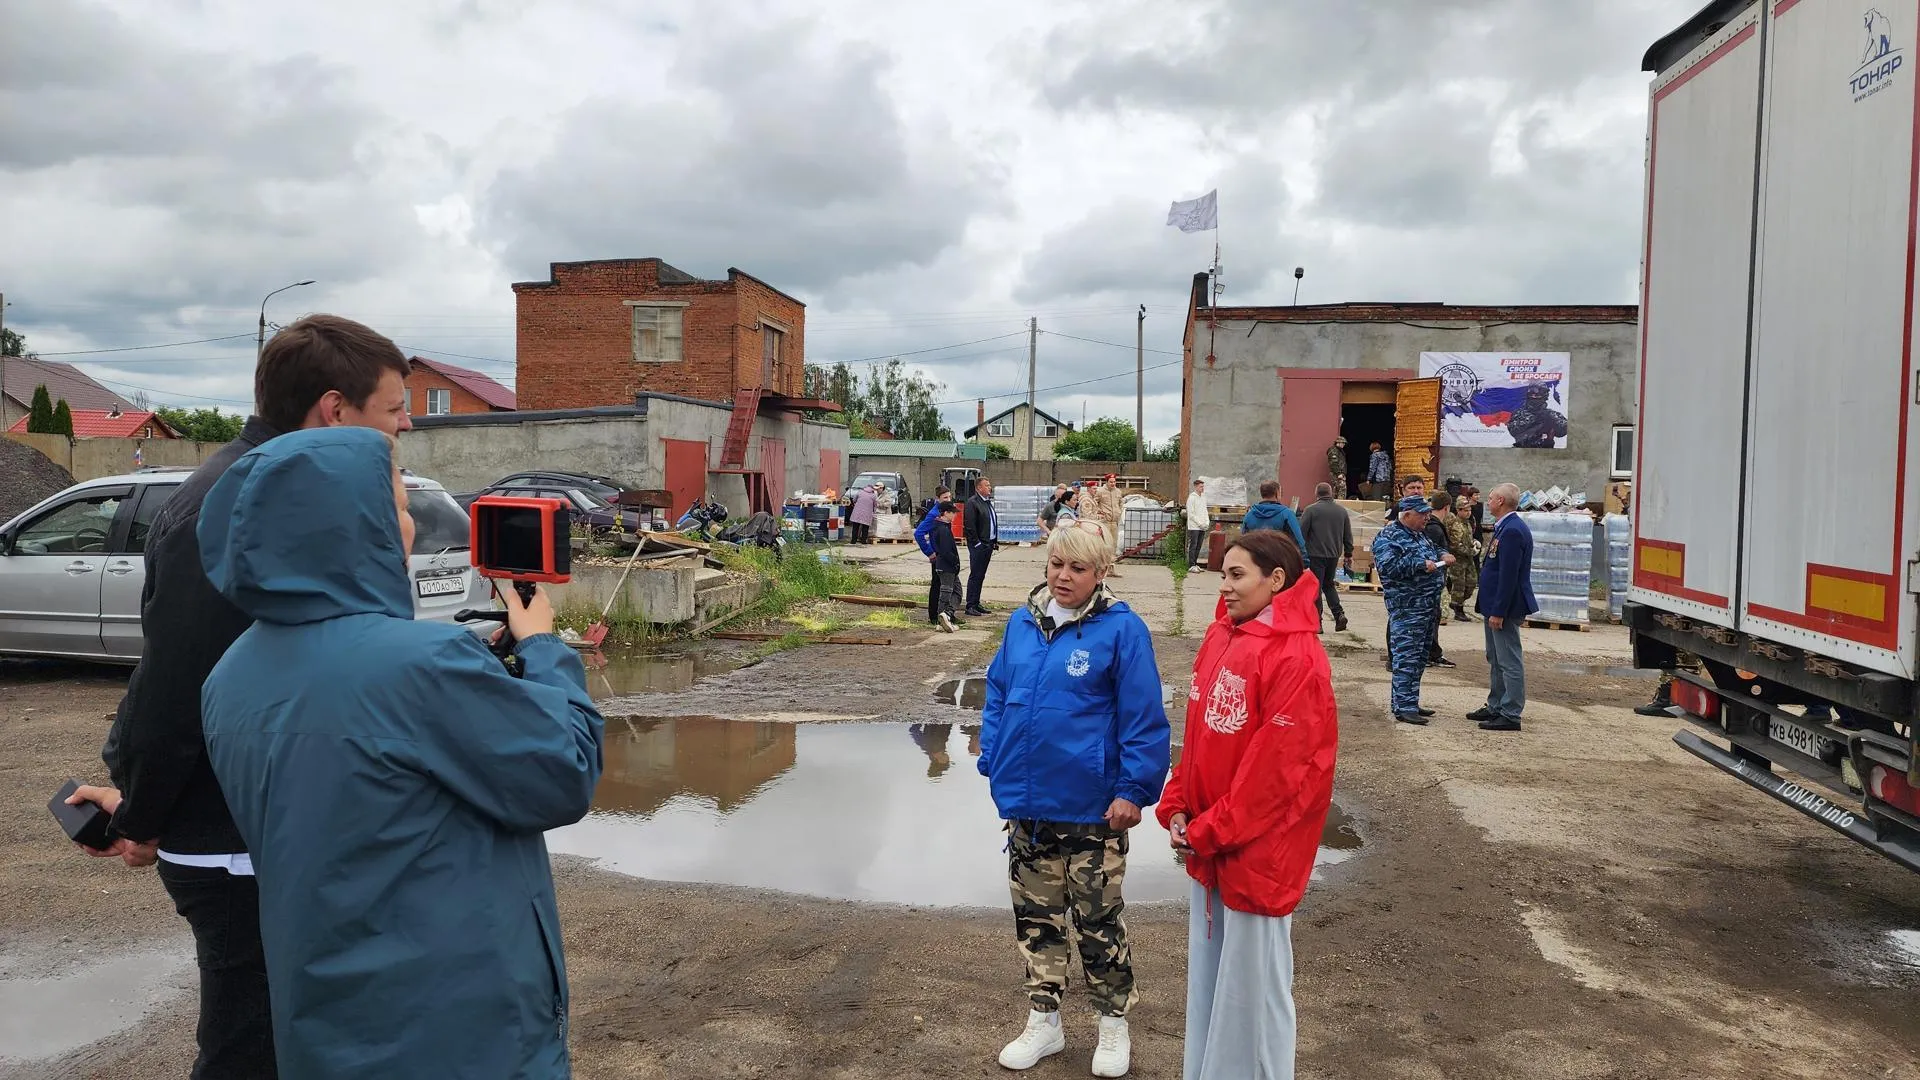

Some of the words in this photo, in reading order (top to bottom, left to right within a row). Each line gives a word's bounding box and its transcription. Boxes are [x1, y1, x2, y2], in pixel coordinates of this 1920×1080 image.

[1849, 55, 1902, 94] ТОНАР
[1854, 78, 1893, 103] www.tonar.info
[1787, 725, 1814, 753] 4981
[1775, 780, 1827, 813] TONAR
